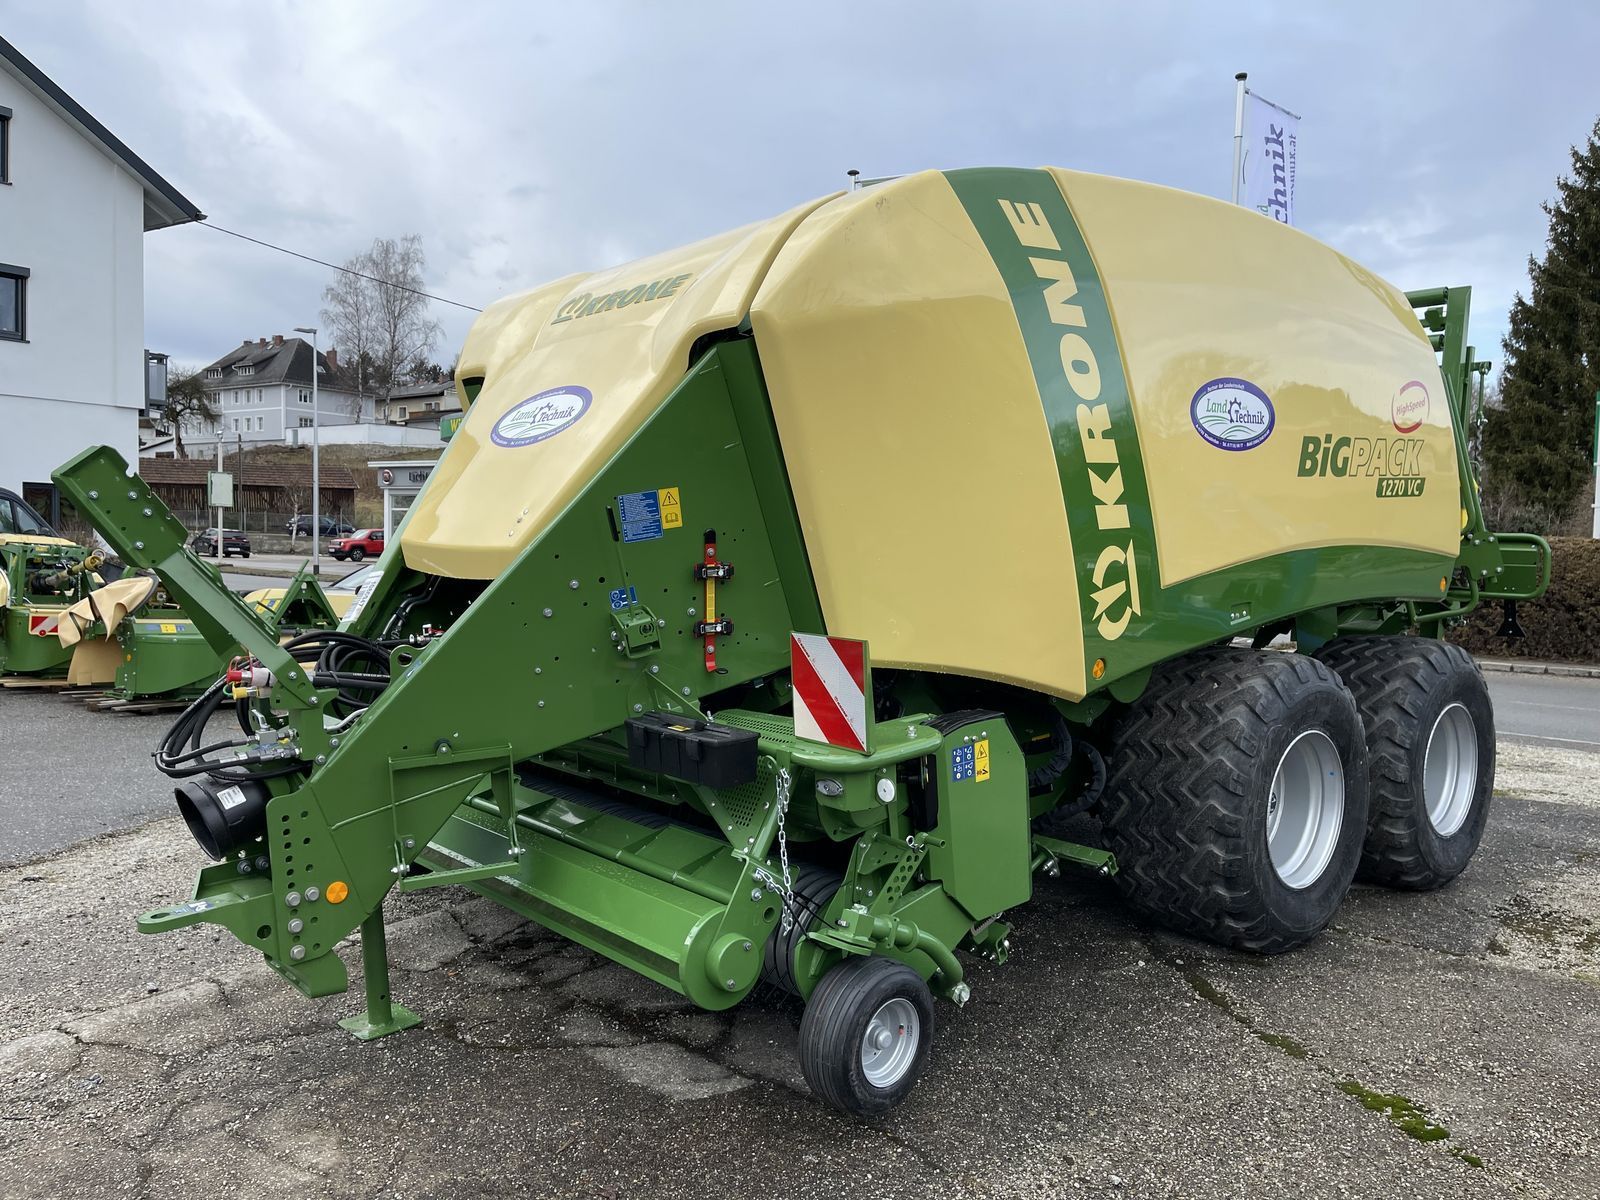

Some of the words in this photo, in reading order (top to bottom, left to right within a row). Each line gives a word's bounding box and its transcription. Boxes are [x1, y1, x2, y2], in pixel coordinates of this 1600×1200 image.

[575, 273, 693, 319] KRONE
[997, 198, 1131, 531] KRONE
[537, 406, 576, 423] Technik
[1206, 398, 1228, 414] Land
[1396, 396, 1426, 417] HighSpeed
[450, 417, 463, 433] W
[1234, 410, 1265, 425] Technik
[1381, 479, 1405, 496] 1270
[1407, 479, 1422, 496] VC
